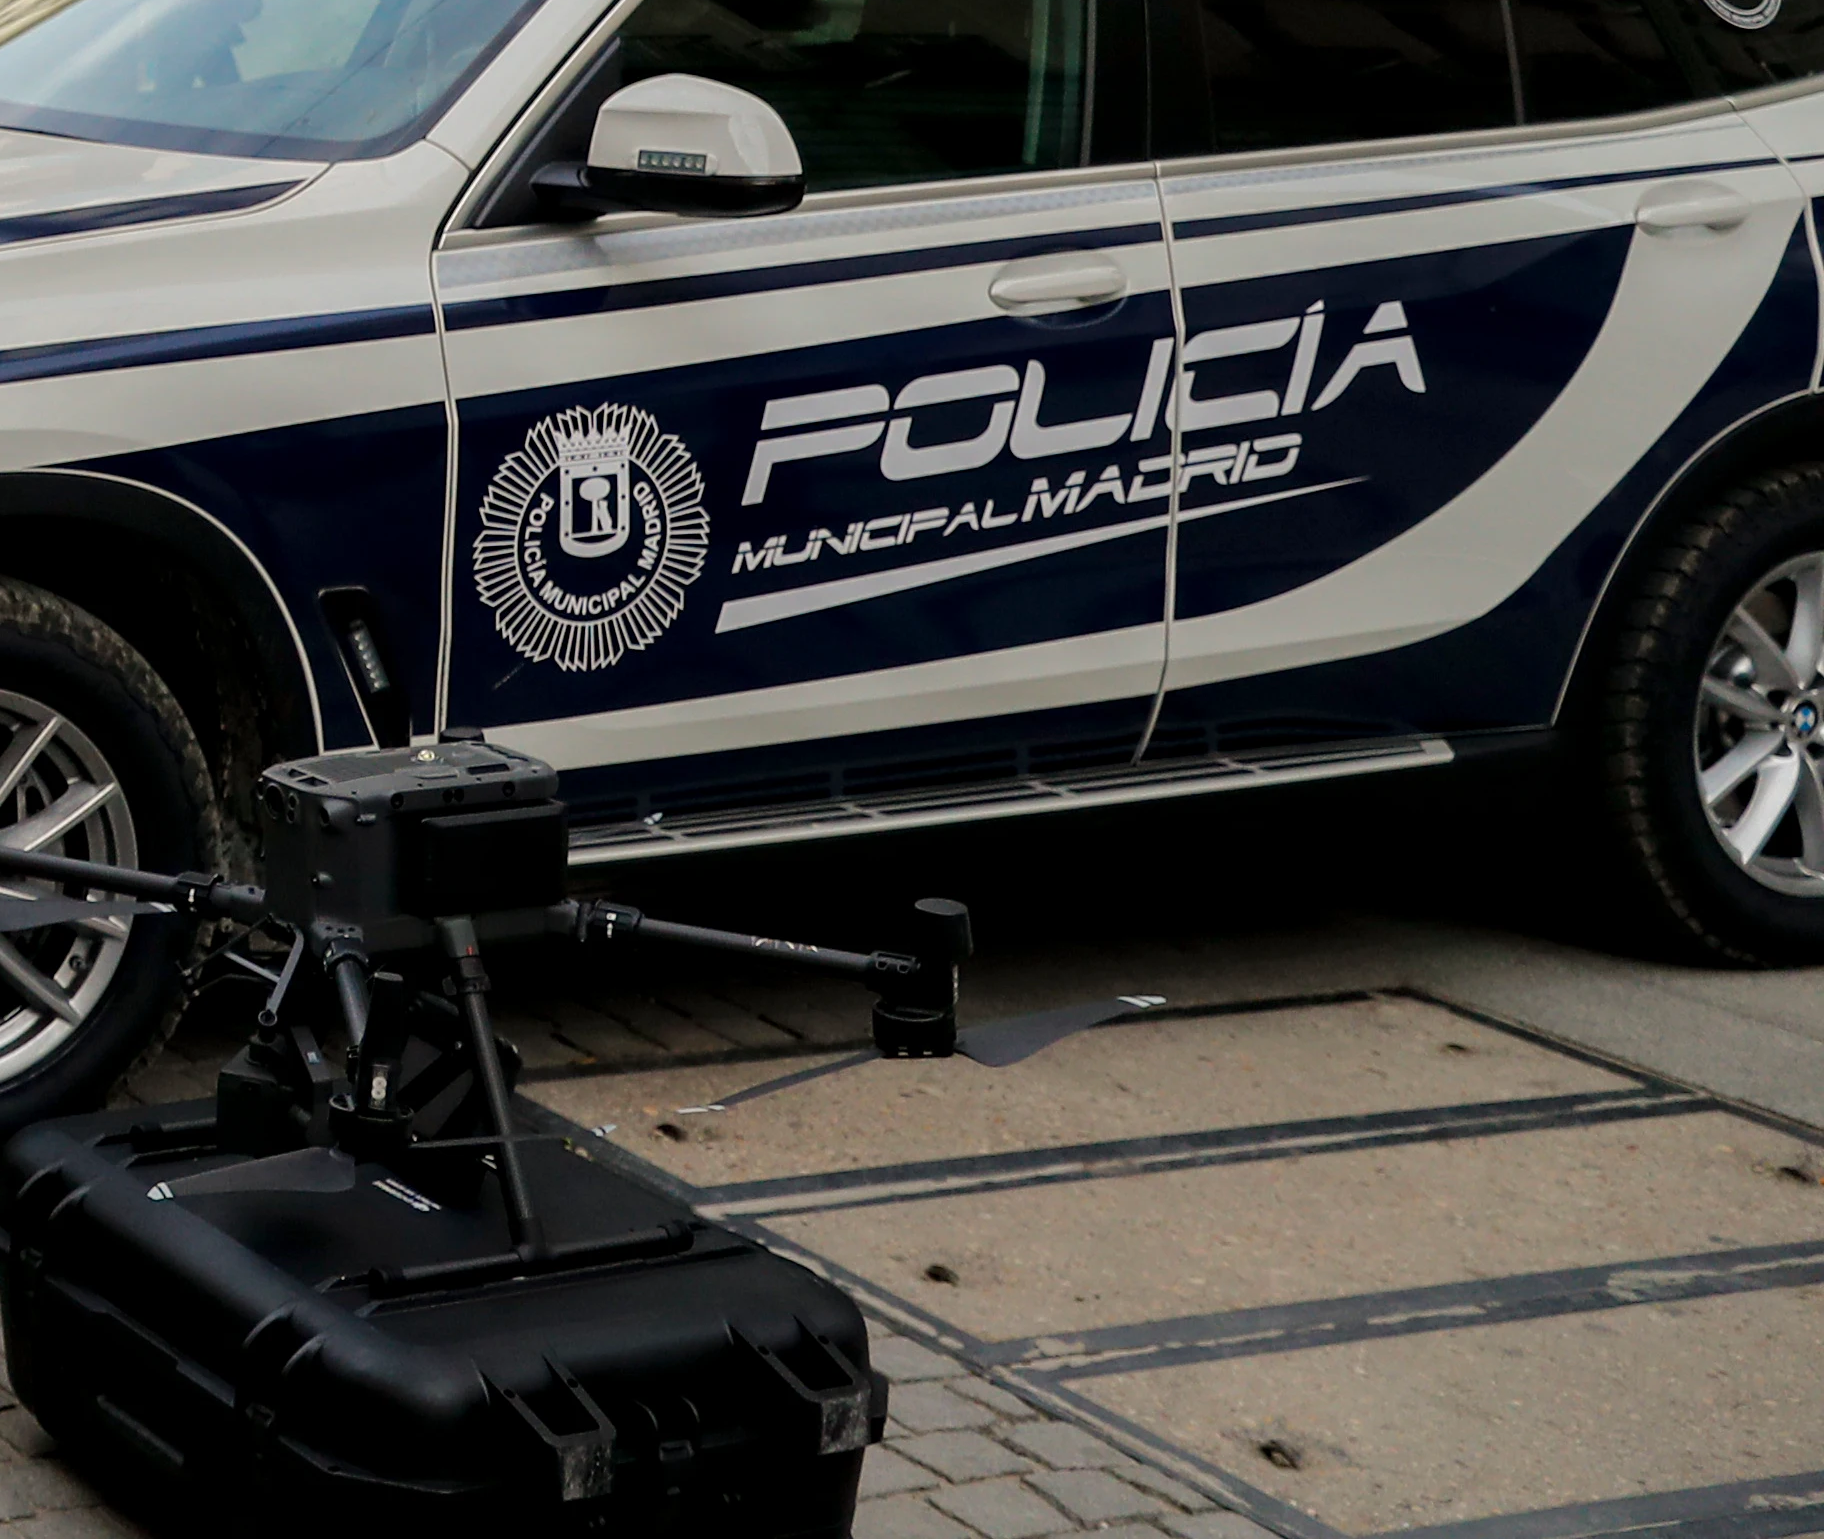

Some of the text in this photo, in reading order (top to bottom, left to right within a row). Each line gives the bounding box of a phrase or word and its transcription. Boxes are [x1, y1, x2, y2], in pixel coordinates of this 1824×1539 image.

[741, 299, 1425, 506] POLICÍA
[523, 481, 662, 616] POLICÍA MUNICIPAL MADRID
[732, 432, 1303, 574] MUNICIPAL MADRID
